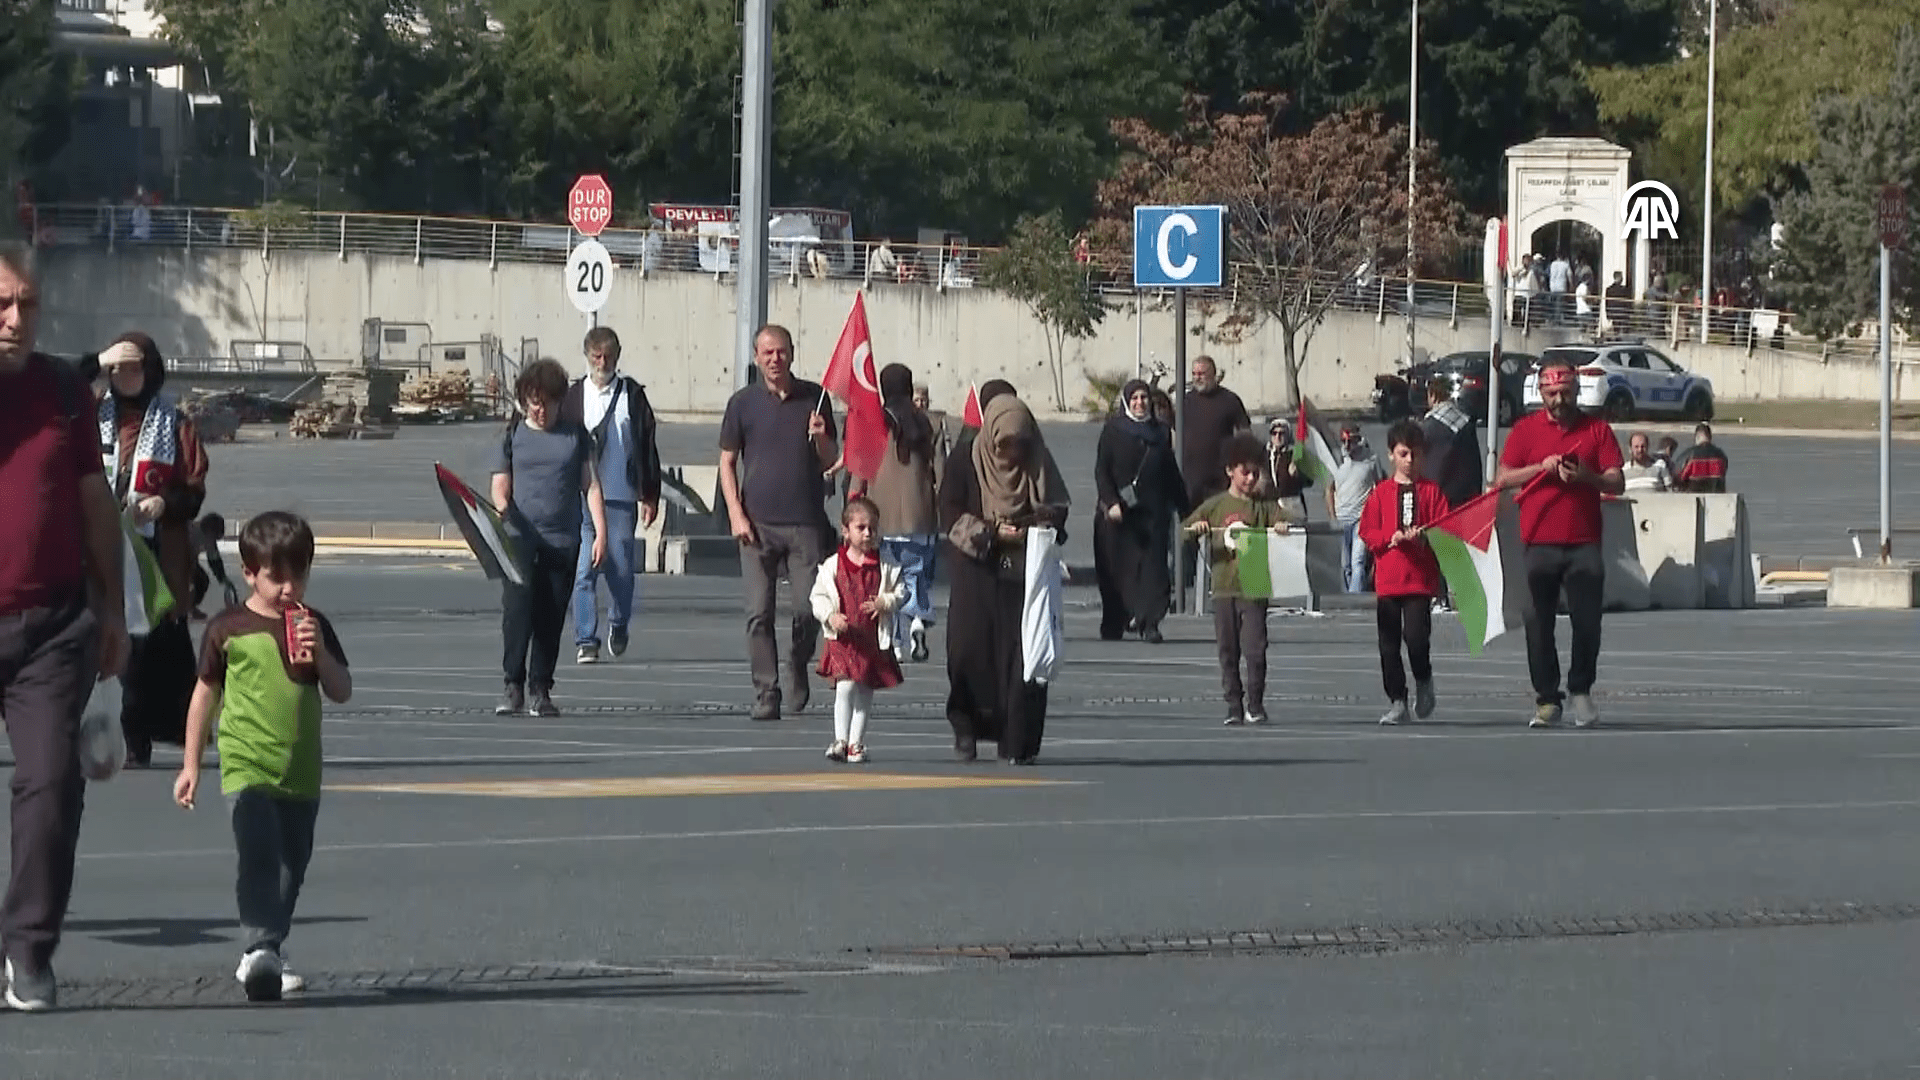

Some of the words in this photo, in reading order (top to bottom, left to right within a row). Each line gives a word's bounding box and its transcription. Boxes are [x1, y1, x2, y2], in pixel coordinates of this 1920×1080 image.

[575, 189, 606, 205] DUR
[573, 207, 608, 222] STOP
[1157, 212, 1198, 280] C
[577, 261, 604, 292] 20
